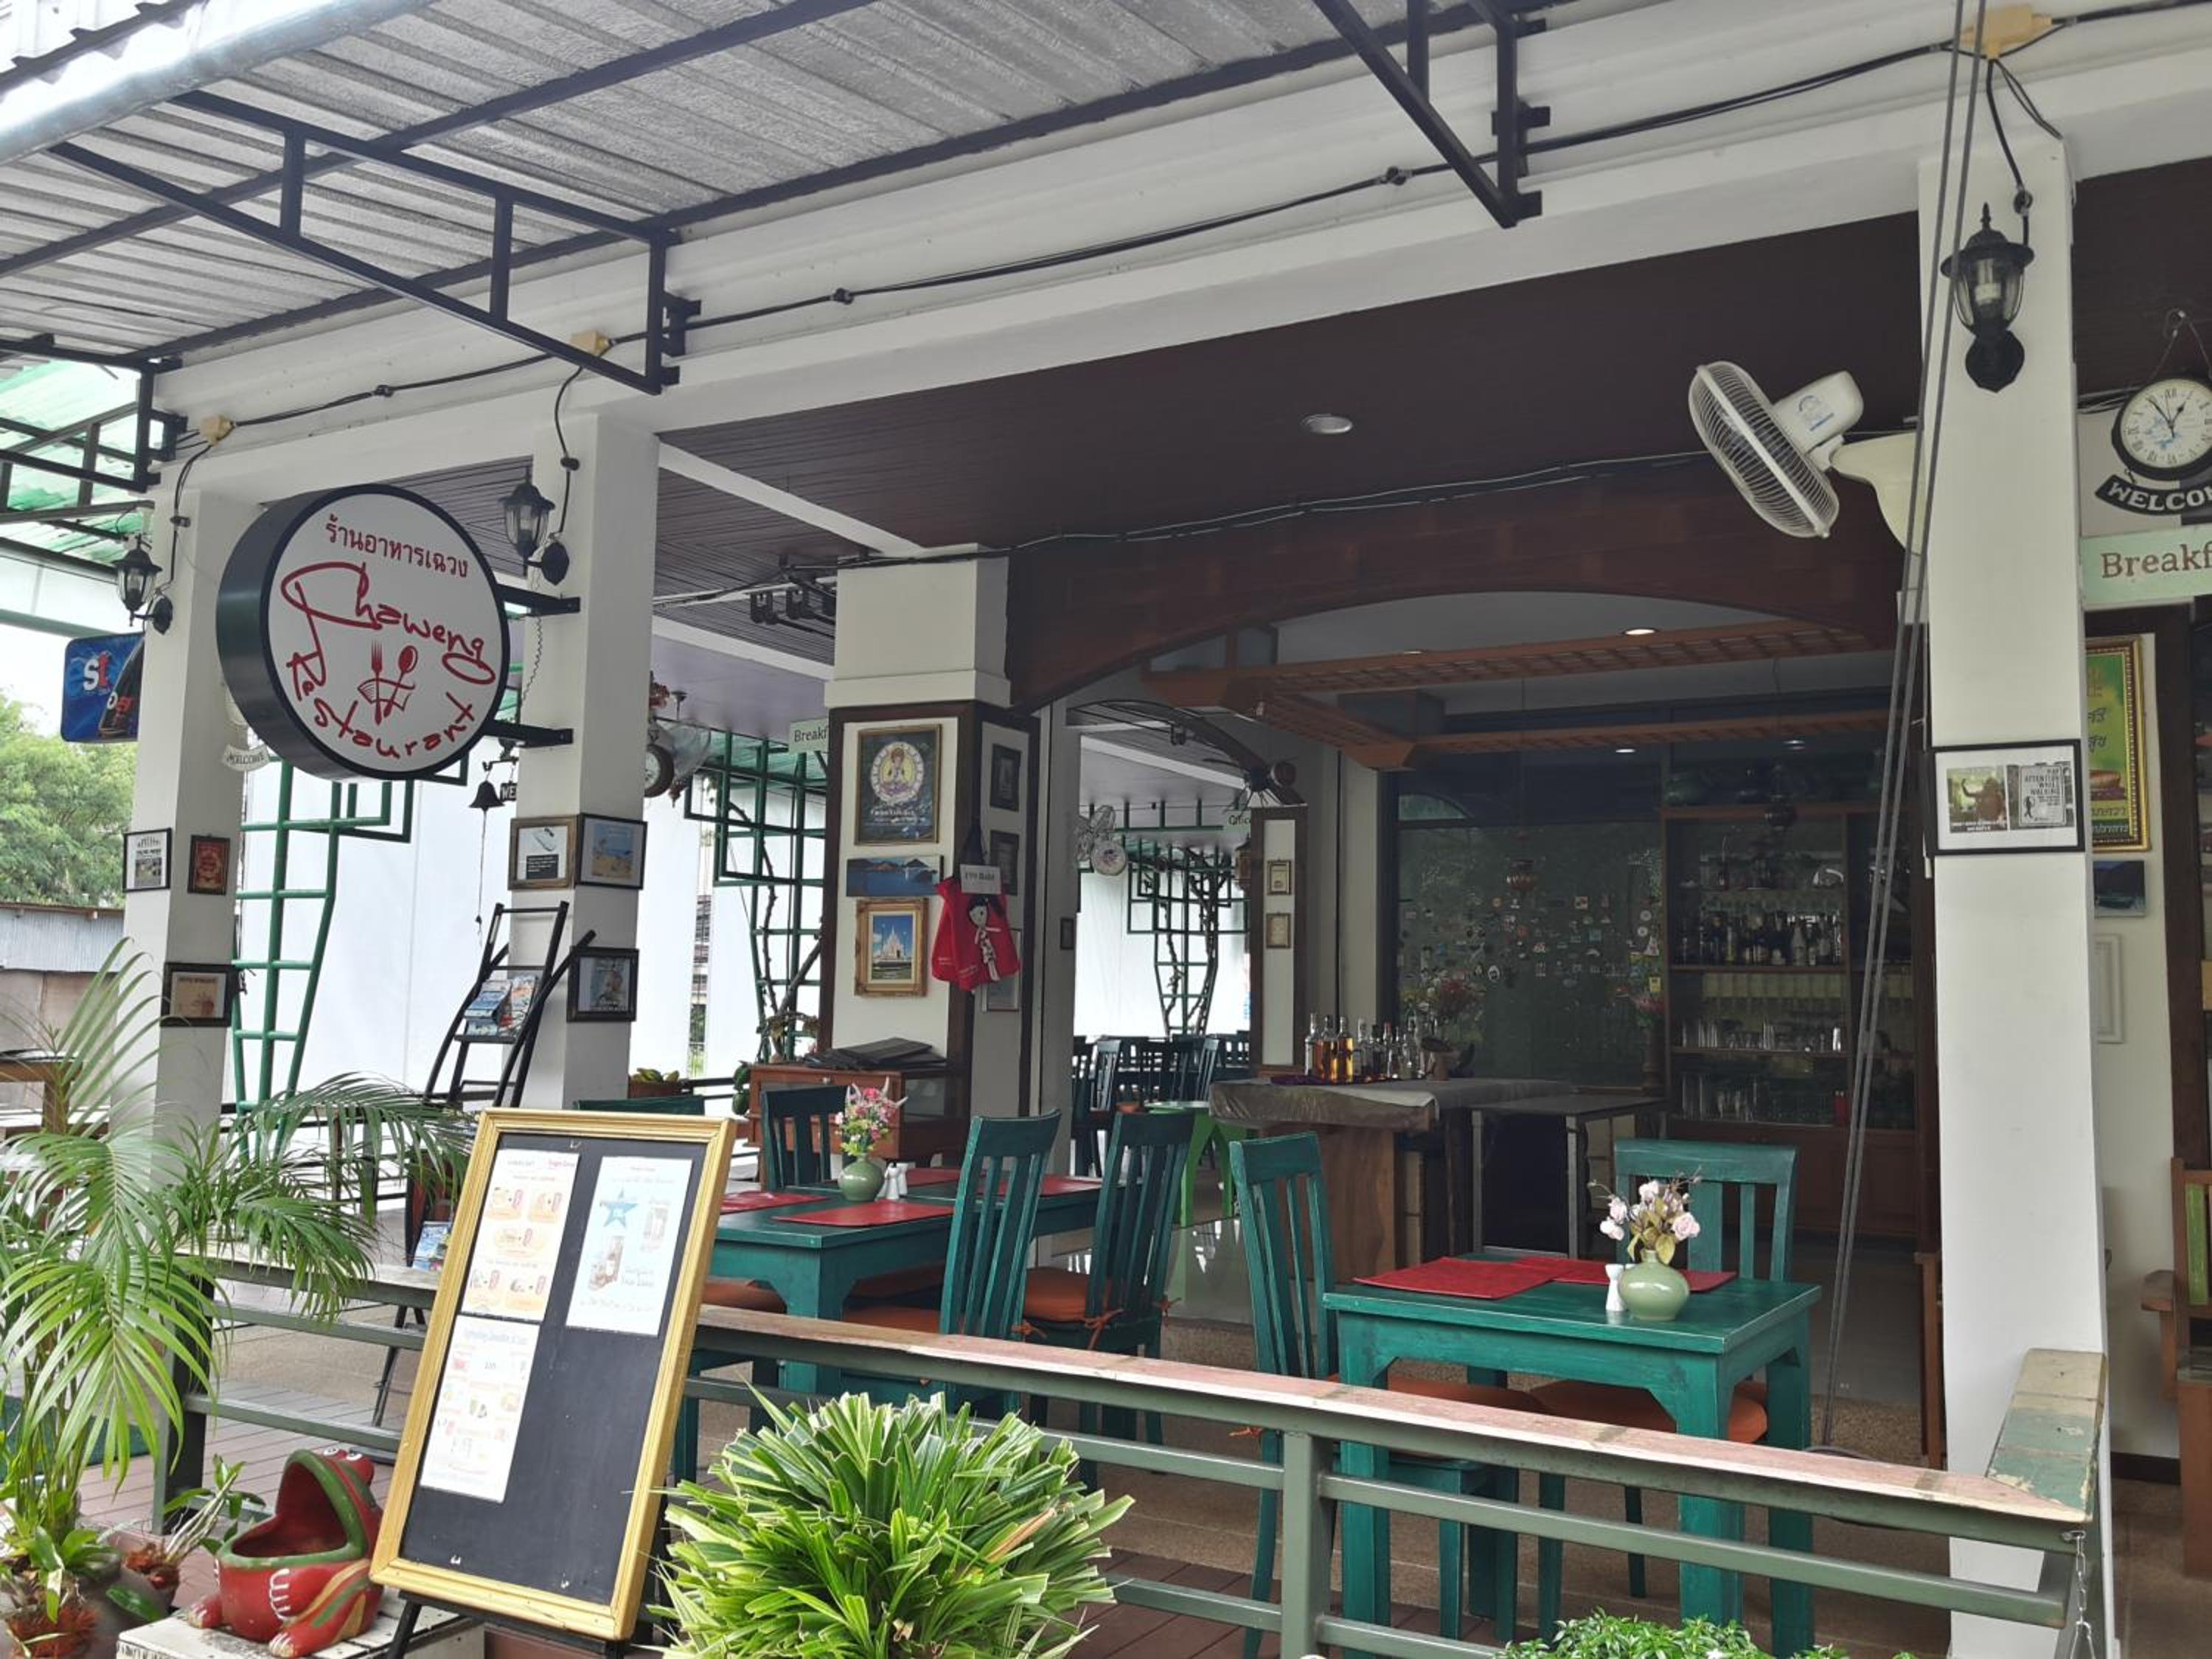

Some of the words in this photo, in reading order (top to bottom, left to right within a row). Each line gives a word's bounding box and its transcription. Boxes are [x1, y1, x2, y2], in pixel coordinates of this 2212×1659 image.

[2107, 481, 2212, 512] WELCO
[326, 514, 469, 578] ร้านอาหารเฉวง
[280, 561, 496, 686] Chaweng
[285, 580, 476, 759] Restaurant
